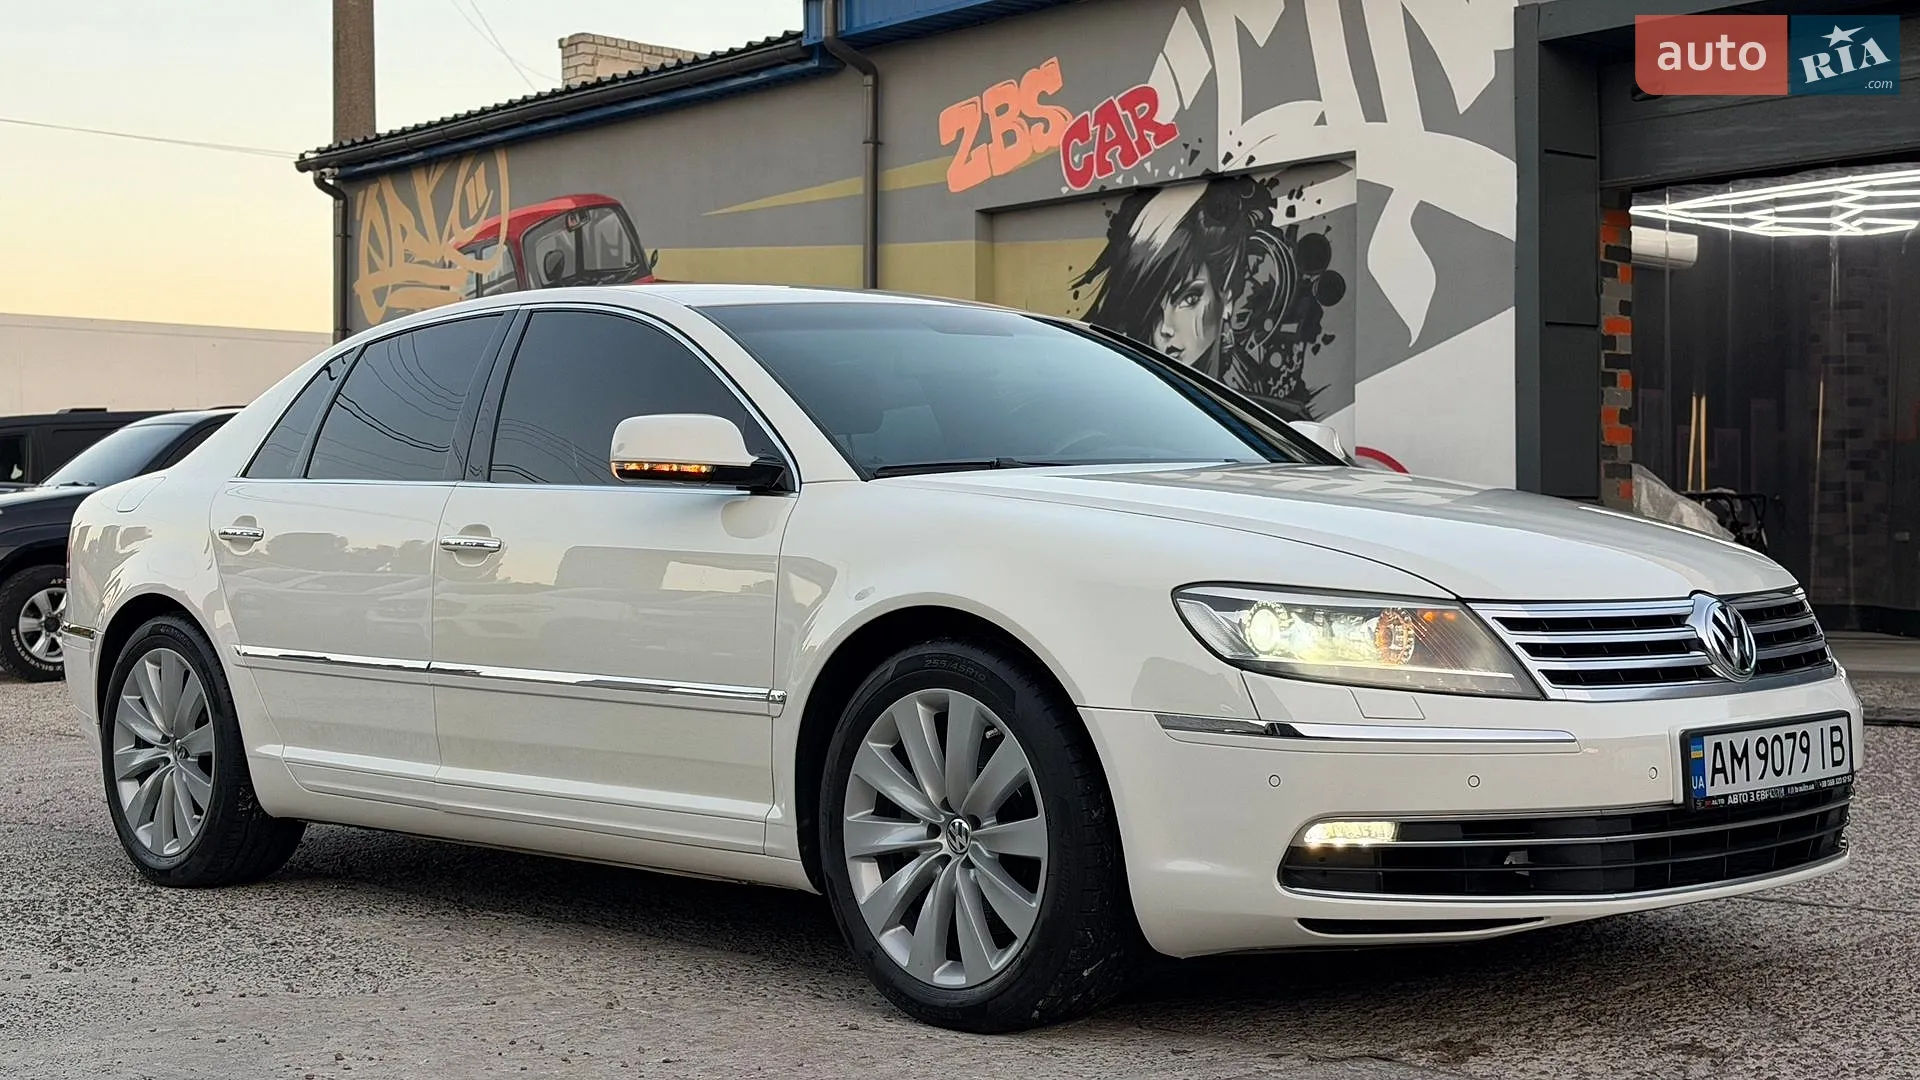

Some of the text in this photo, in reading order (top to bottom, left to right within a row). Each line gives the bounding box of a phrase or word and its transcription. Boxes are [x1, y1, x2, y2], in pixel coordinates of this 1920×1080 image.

[939, 56, 1180, 193] ZBS CAR
[1691, 775, 1705, 790] UA
[1710, 725, 1846, 787] AM 9079 IB
